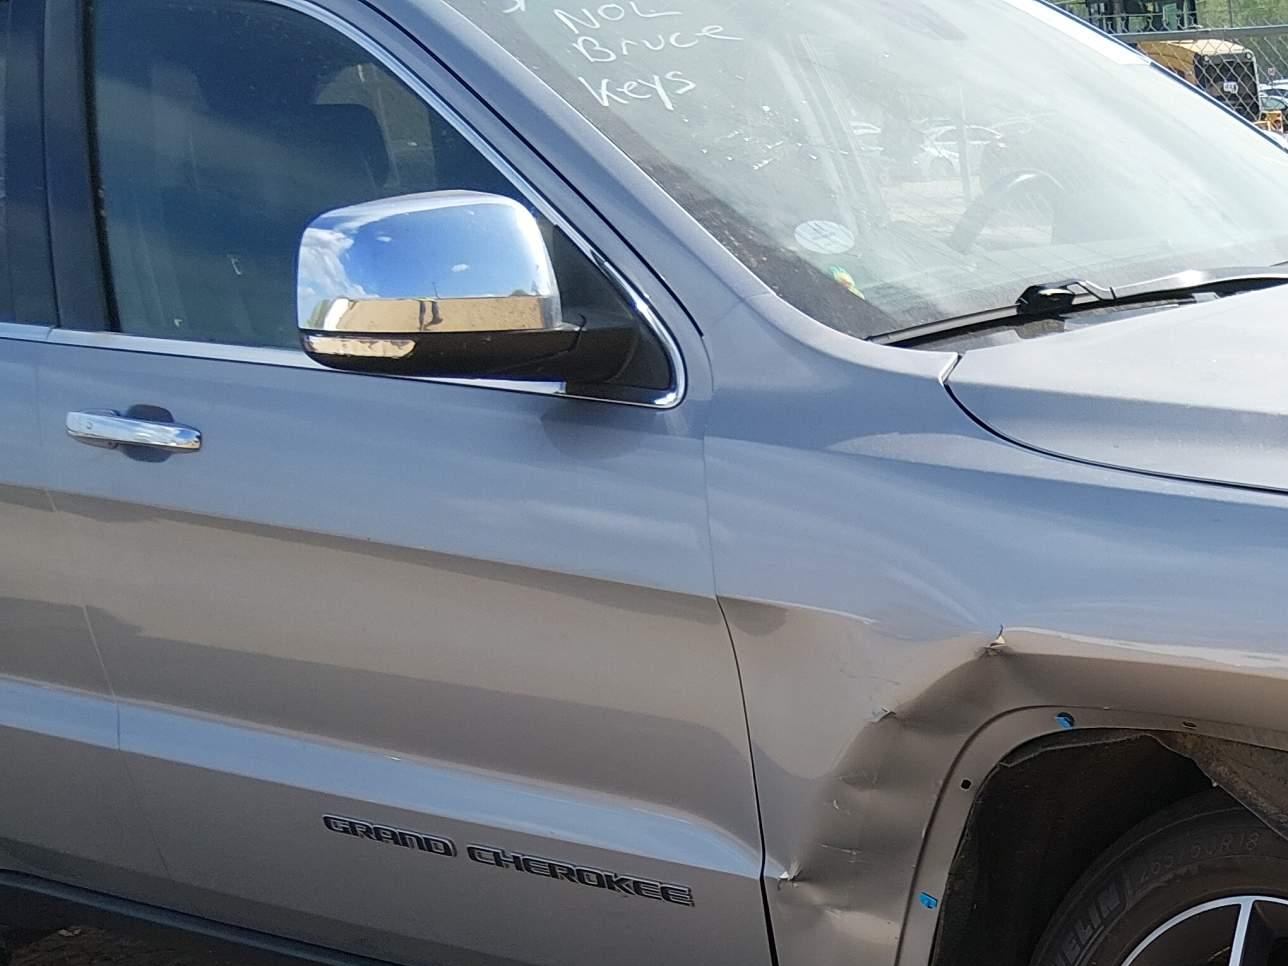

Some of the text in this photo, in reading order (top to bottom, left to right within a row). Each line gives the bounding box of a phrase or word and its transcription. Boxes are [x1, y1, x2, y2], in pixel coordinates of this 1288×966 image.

[571, 25, 745, 63] Bruce
[321, 813, 695, 907] GRAND CHEROKEE
